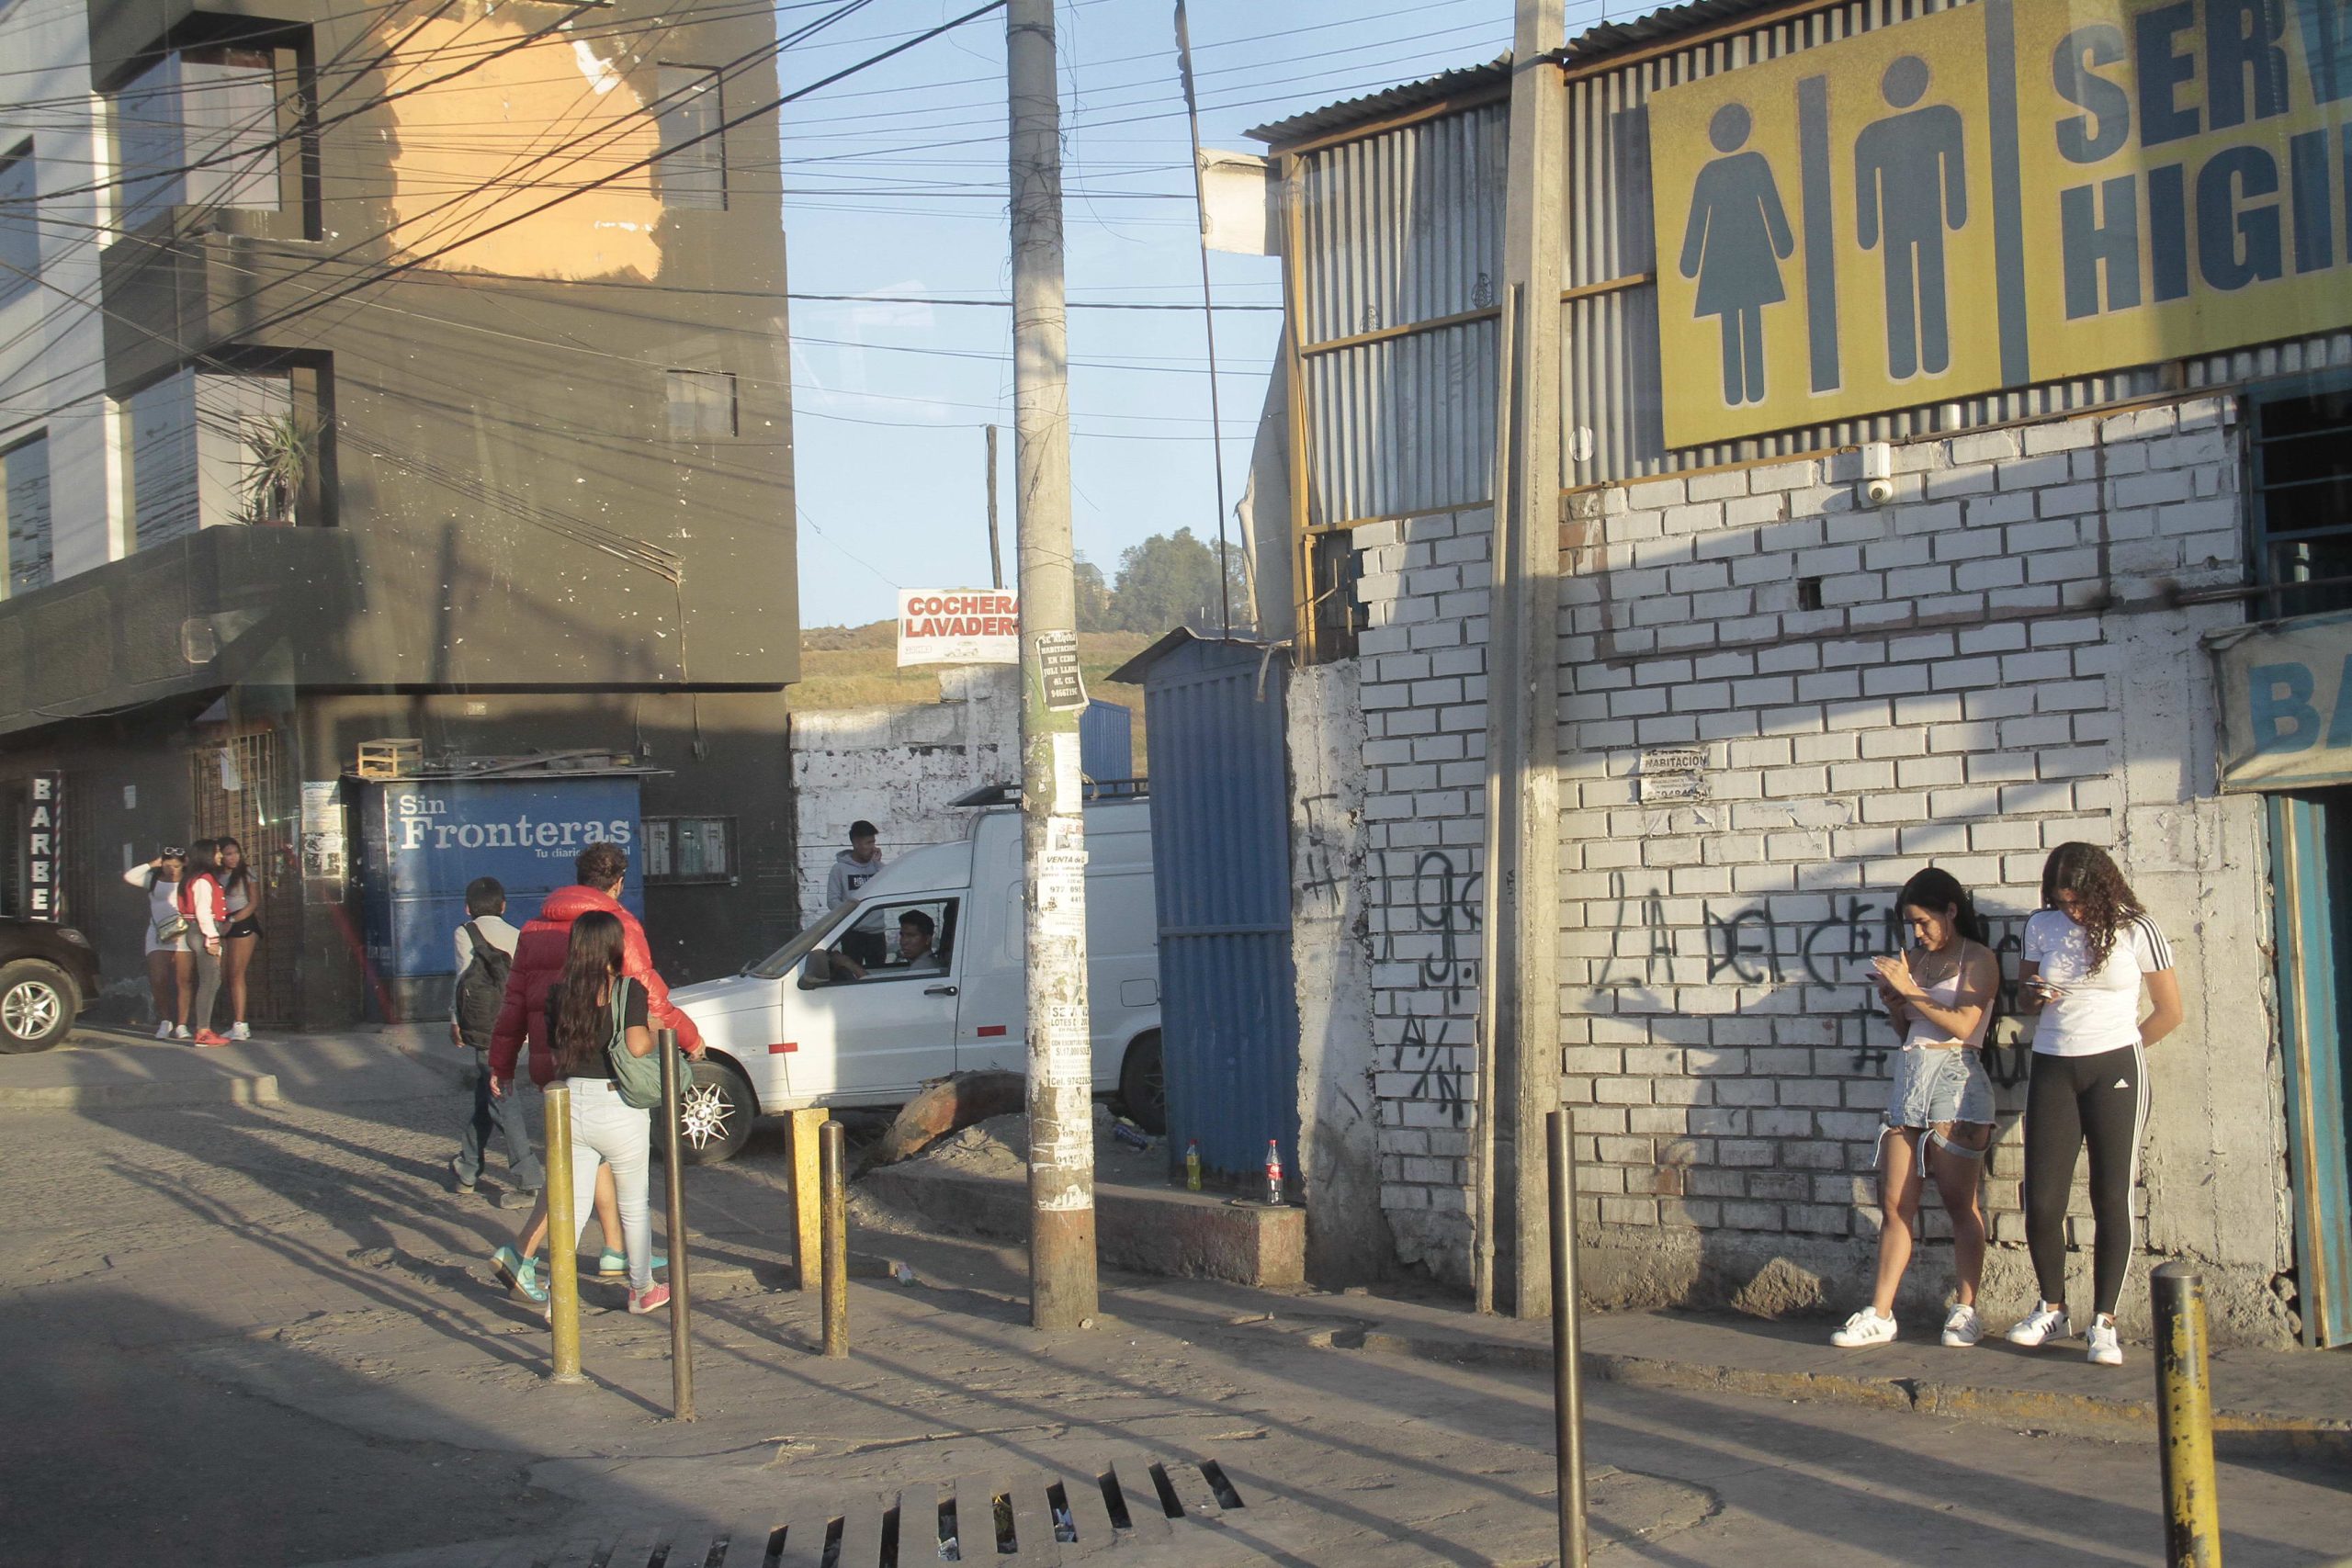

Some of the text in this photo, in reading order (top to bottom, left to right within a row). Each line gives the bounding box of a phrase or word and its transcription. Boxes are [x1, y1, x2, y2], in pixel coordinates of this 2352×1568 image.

[1645, 756, 1707, 768] HABITACION
[400, 794, 447, 816] Sin
[401, 814, 631, 851] Fronteras
[30, 778, 51, 920] BARBE
[535, 848, 548, 858] Tu
[1046, 855, 1073, 863] VENTA
[1051, 1018, 1071, 1027] LOTES
